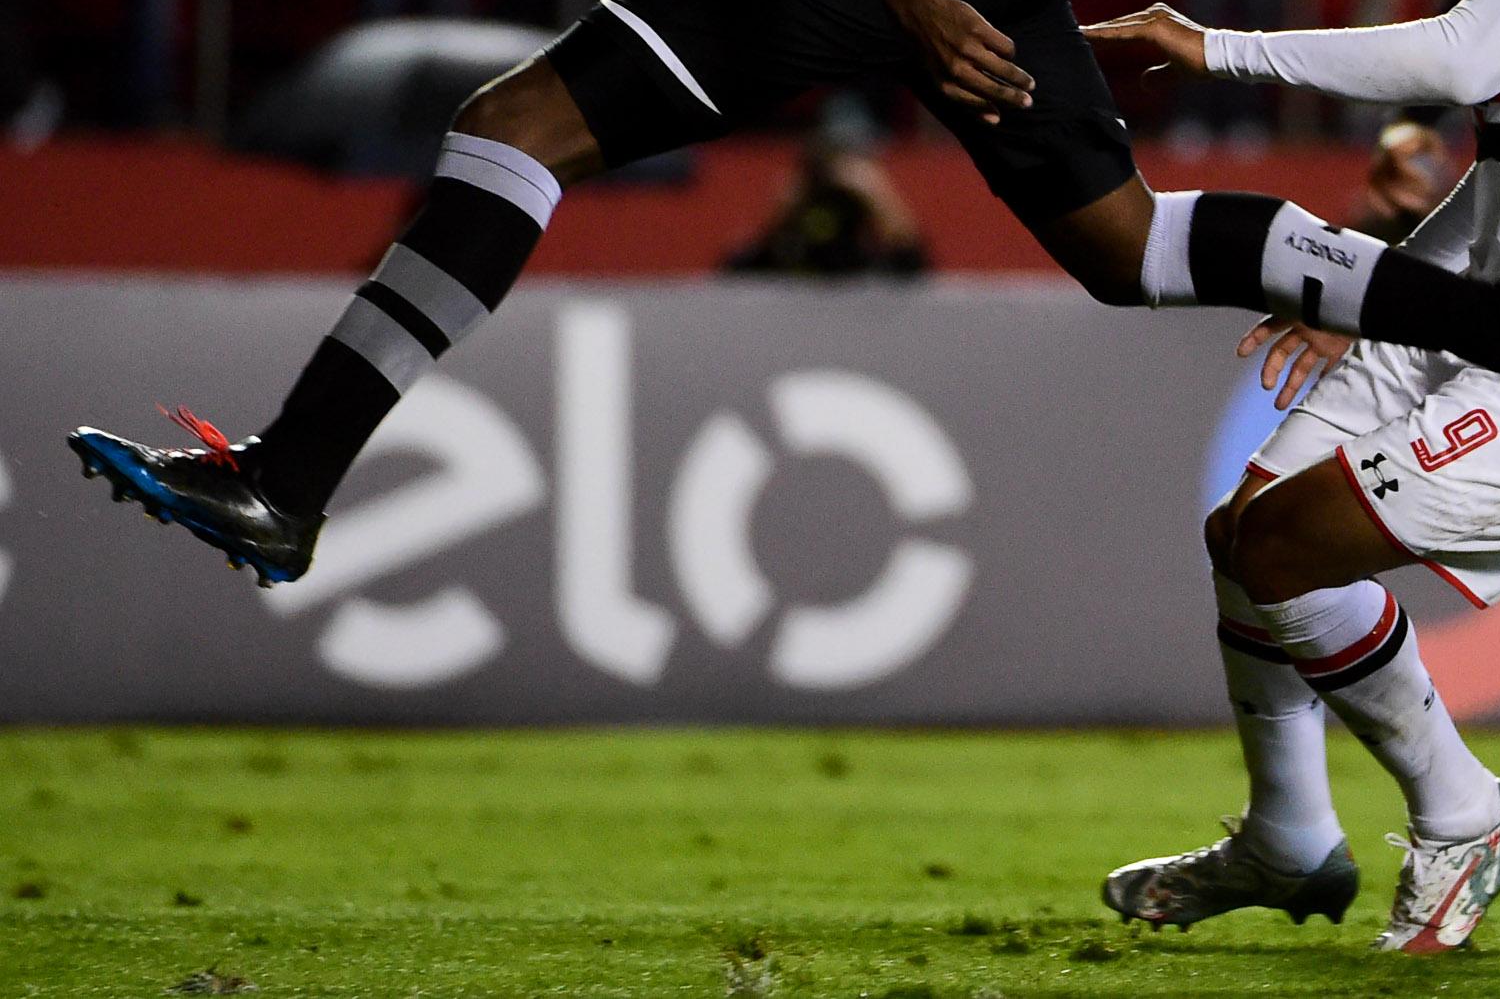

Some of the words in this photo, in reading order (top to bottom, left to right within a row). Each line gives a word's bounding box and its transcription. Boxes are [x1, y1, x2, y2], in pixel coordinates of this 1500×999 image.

[1284, 231, 1357, 270] PENALTY
[1411, 408, 1498, 472] 9
[262, 304, 974, 688] elo
